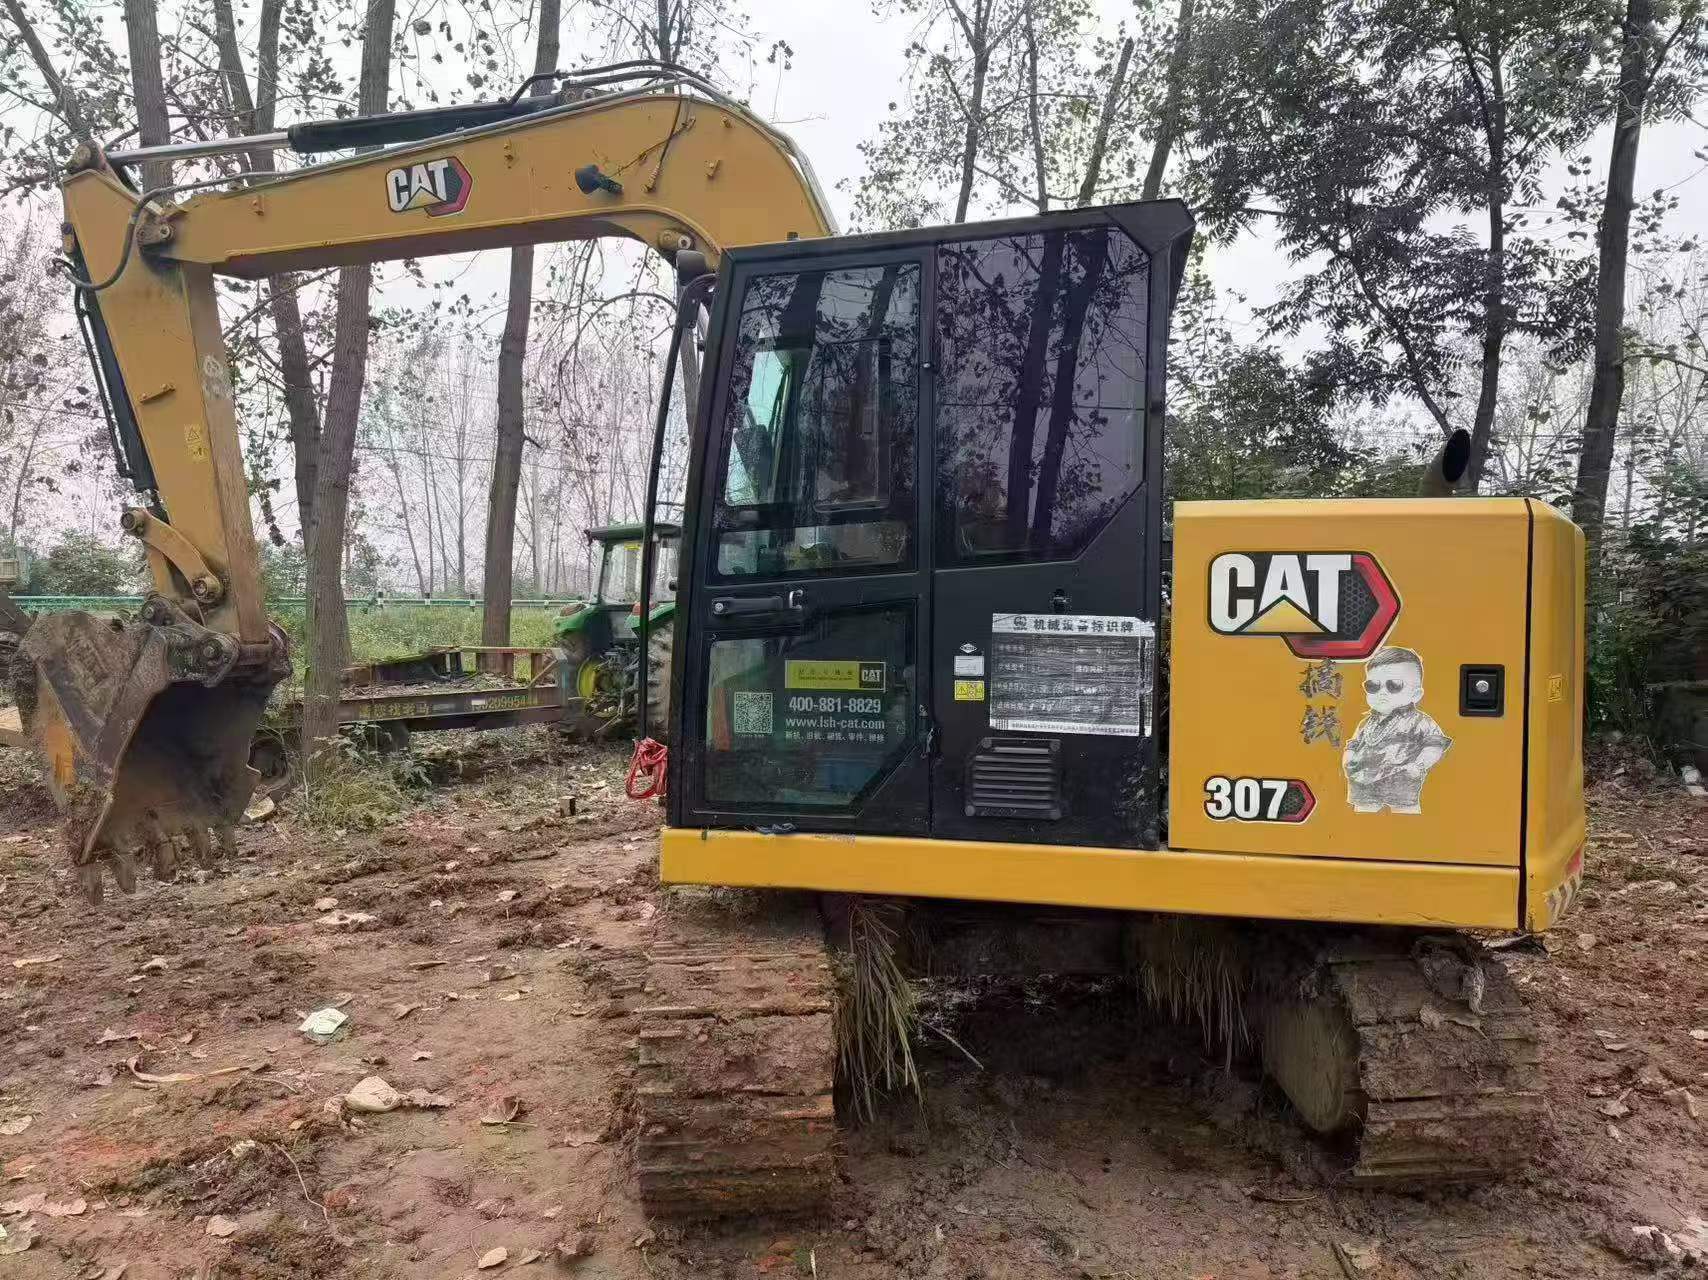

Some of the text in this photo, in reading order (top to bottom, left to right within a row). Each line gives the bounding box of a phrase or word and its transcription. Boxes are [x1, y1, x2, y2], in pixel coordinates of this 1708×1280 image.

[386, 159, 449, 211] CAT
[1210, 553, 1351, 632] CAT
[861, 669, 882, 682] CAT
[788, 696, 881, 713] 400-881-8829
[785, 715, 885, 730] www.lsh-cat.com
[1205, 777, 1288, 819] 307
